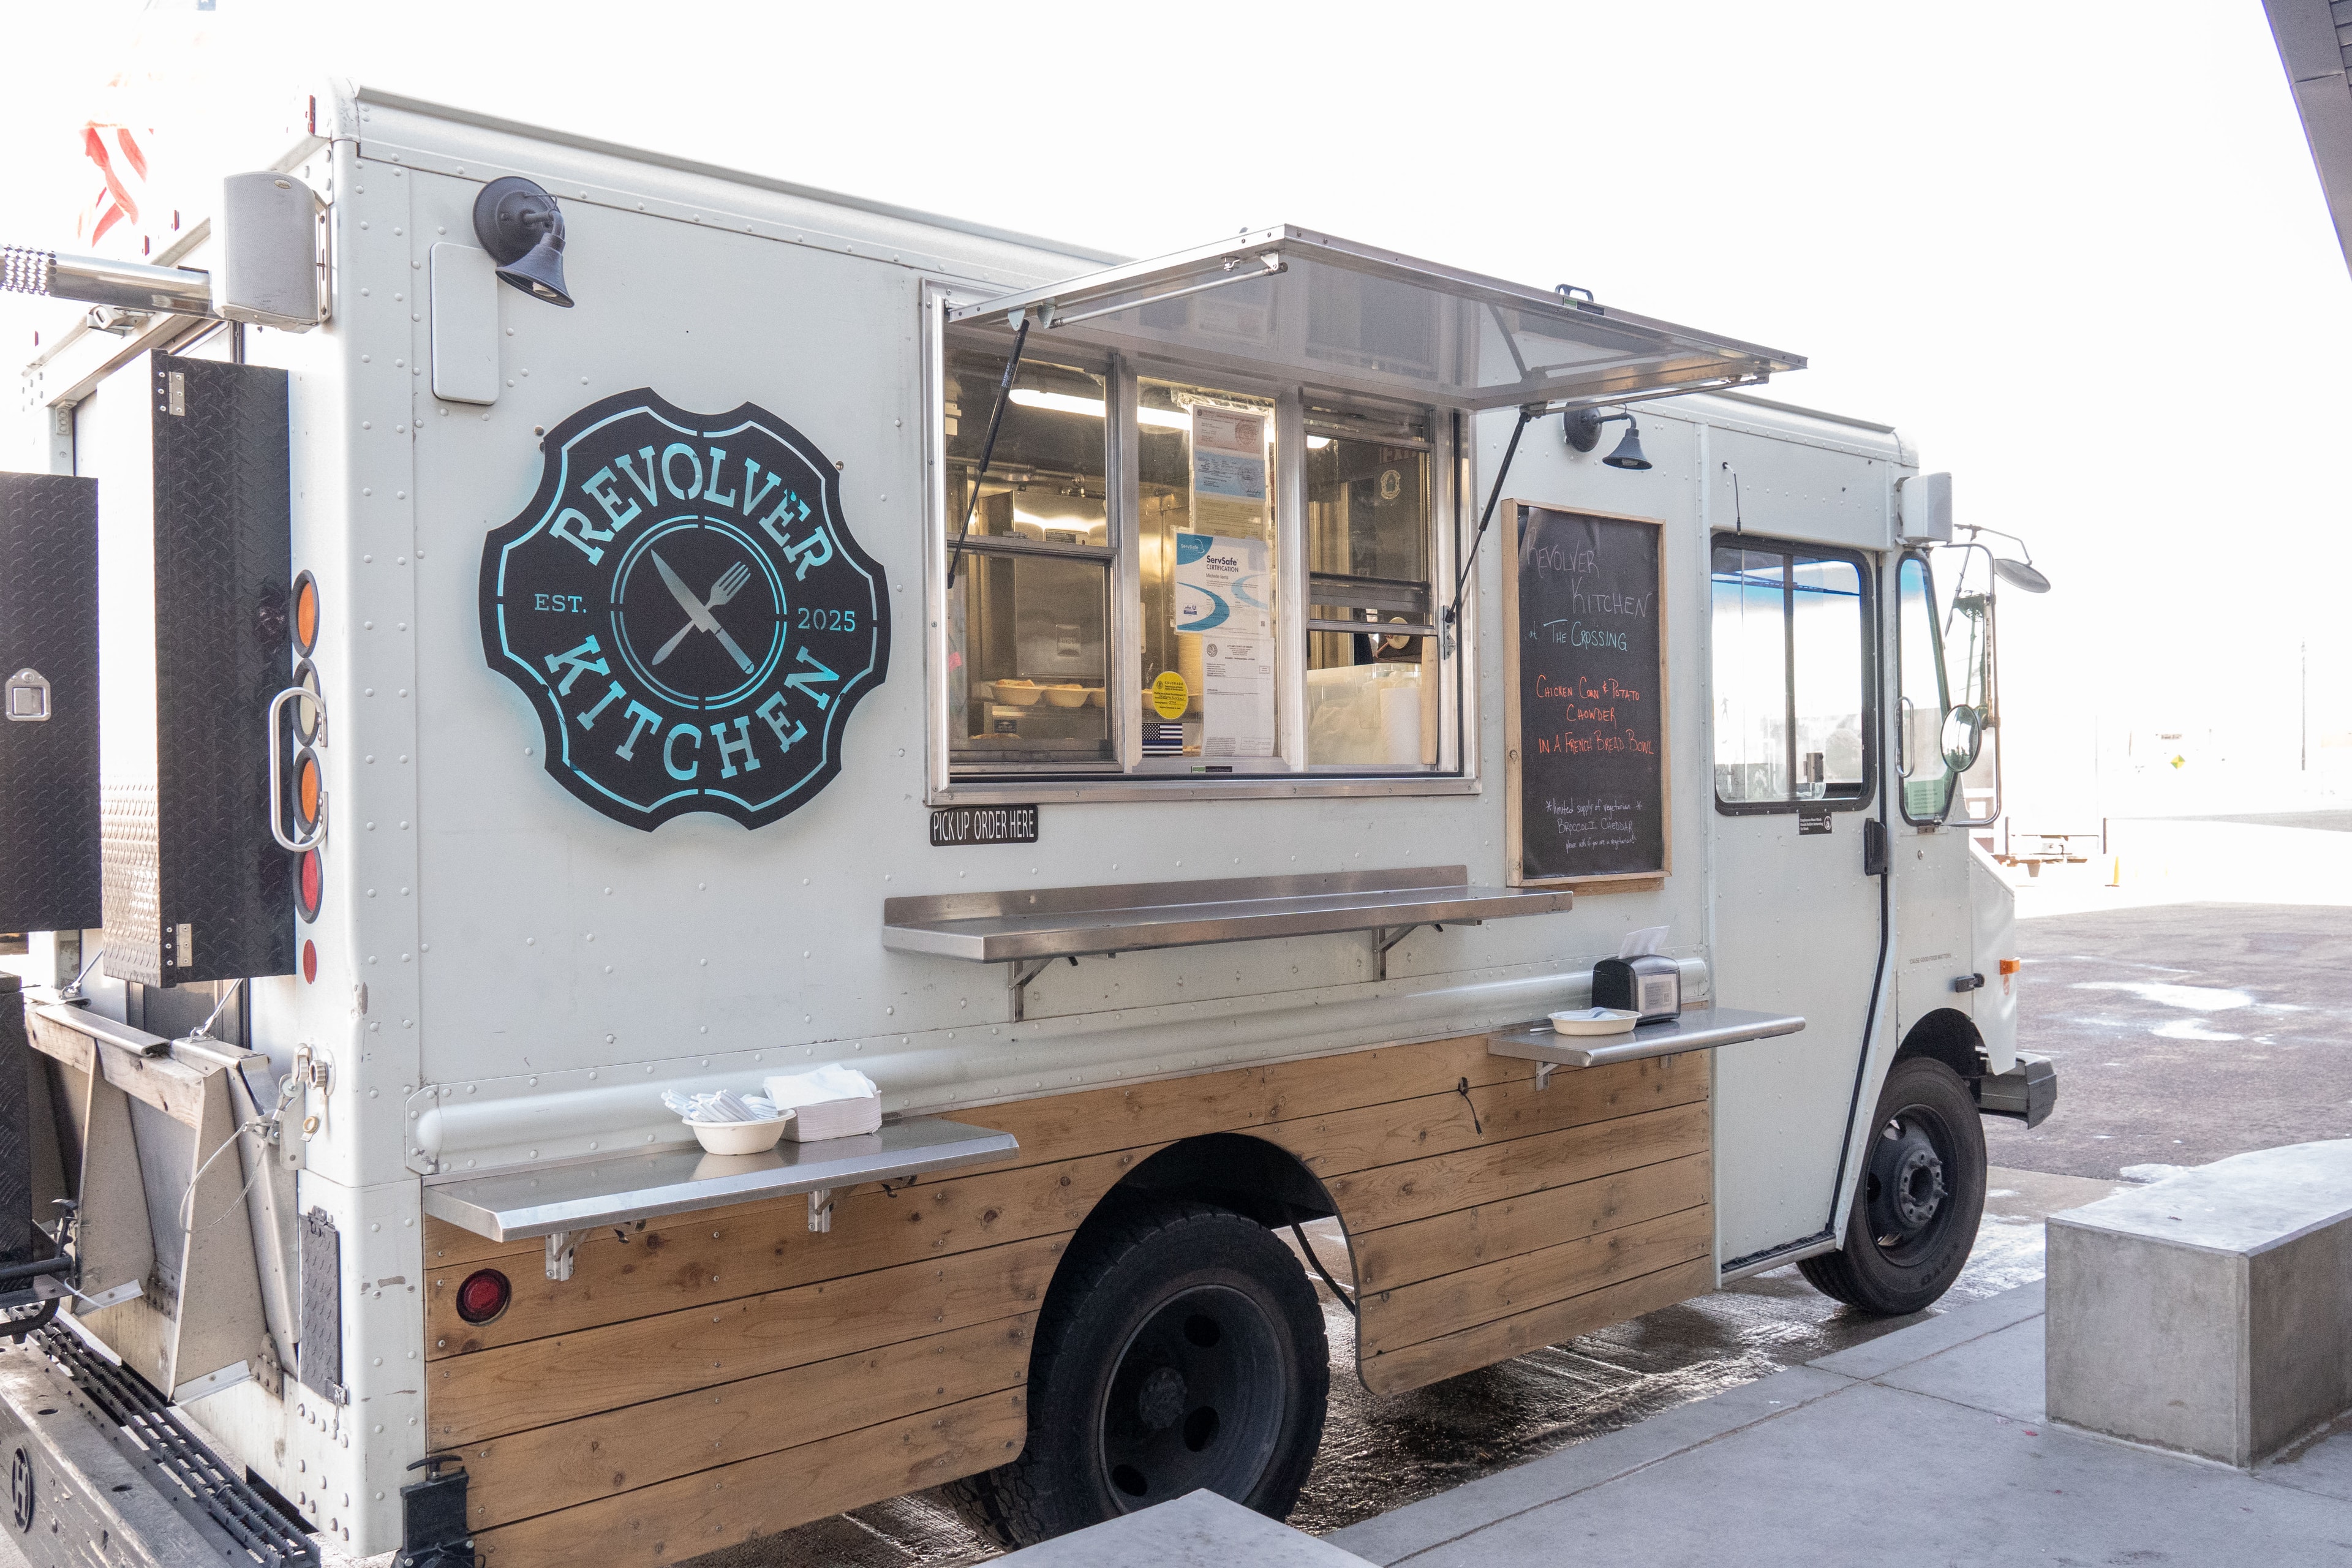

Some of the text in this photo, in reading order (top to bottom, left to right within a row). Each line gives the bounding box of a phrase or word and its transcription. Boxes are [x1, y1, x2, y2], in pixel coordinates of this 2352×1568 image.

[549, 442, 833, 581] REVOLVER
[1207, 556, 1237, 565] ServSafe
[1527, 527, 1599, 578] REVOLVER
[1207, 564, 1239, 573] CERTIFICATION
[534, 594, 587, 612] EST.
[1572, 576, 1653, 619] KITCHEN
[797, 608, 856, 632] 2025
[1529, 621, 1537, 639] at
[1571, 622, 1627, 651] CROSSING
[1536, 674, 1572, 698] CHICKEN
[1608, 678, 1640, 701] POTATO
[545, 635, 840, 781] KITCHEN
[1566, 704, 1617, 729] CHOWDER
[1539, 729, 1654, 755] IN A FRENCH BREAD BOWL
[1594, 799, 1602, 811] of
[957, 811, 970, 840] UP
[974, 810, 1008, 840] ORDER
[1010, 810, 1035, 839] HERE
[1601, 818, 1637, 840] CHEDDAR
